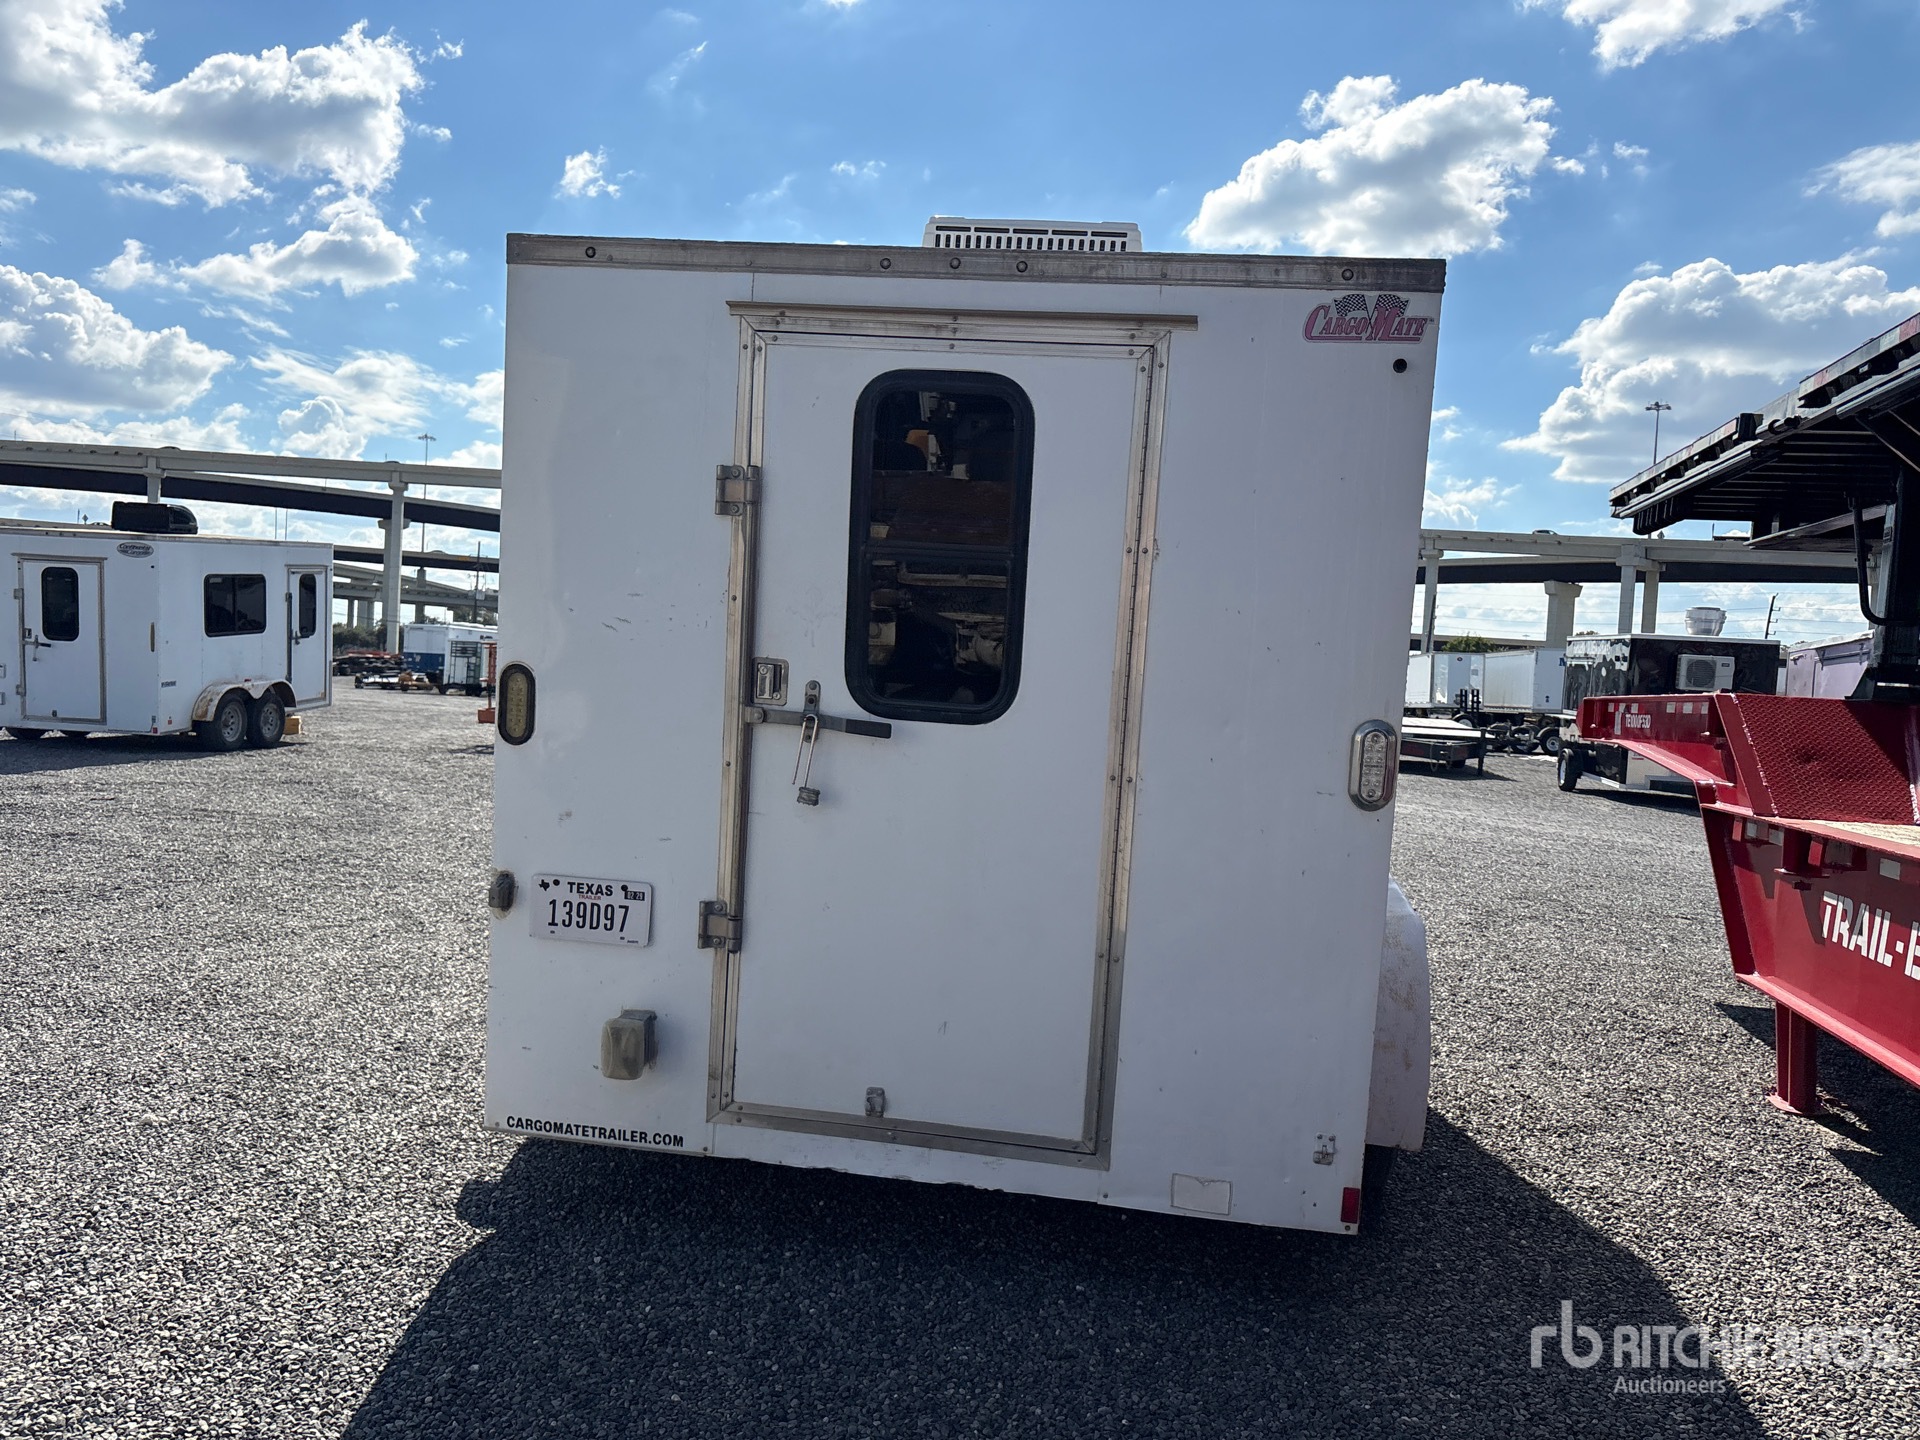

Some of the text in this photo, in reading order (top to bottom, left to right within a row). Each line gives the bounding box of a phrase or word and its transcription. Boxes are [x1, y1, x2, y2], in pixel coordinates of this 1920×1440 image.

[567, 881, 614, 897] TEXAS
[548, 899, 630, 933] 139D97
[506, 1115, 684, 1148] CARGOMATETRAILER.COM
